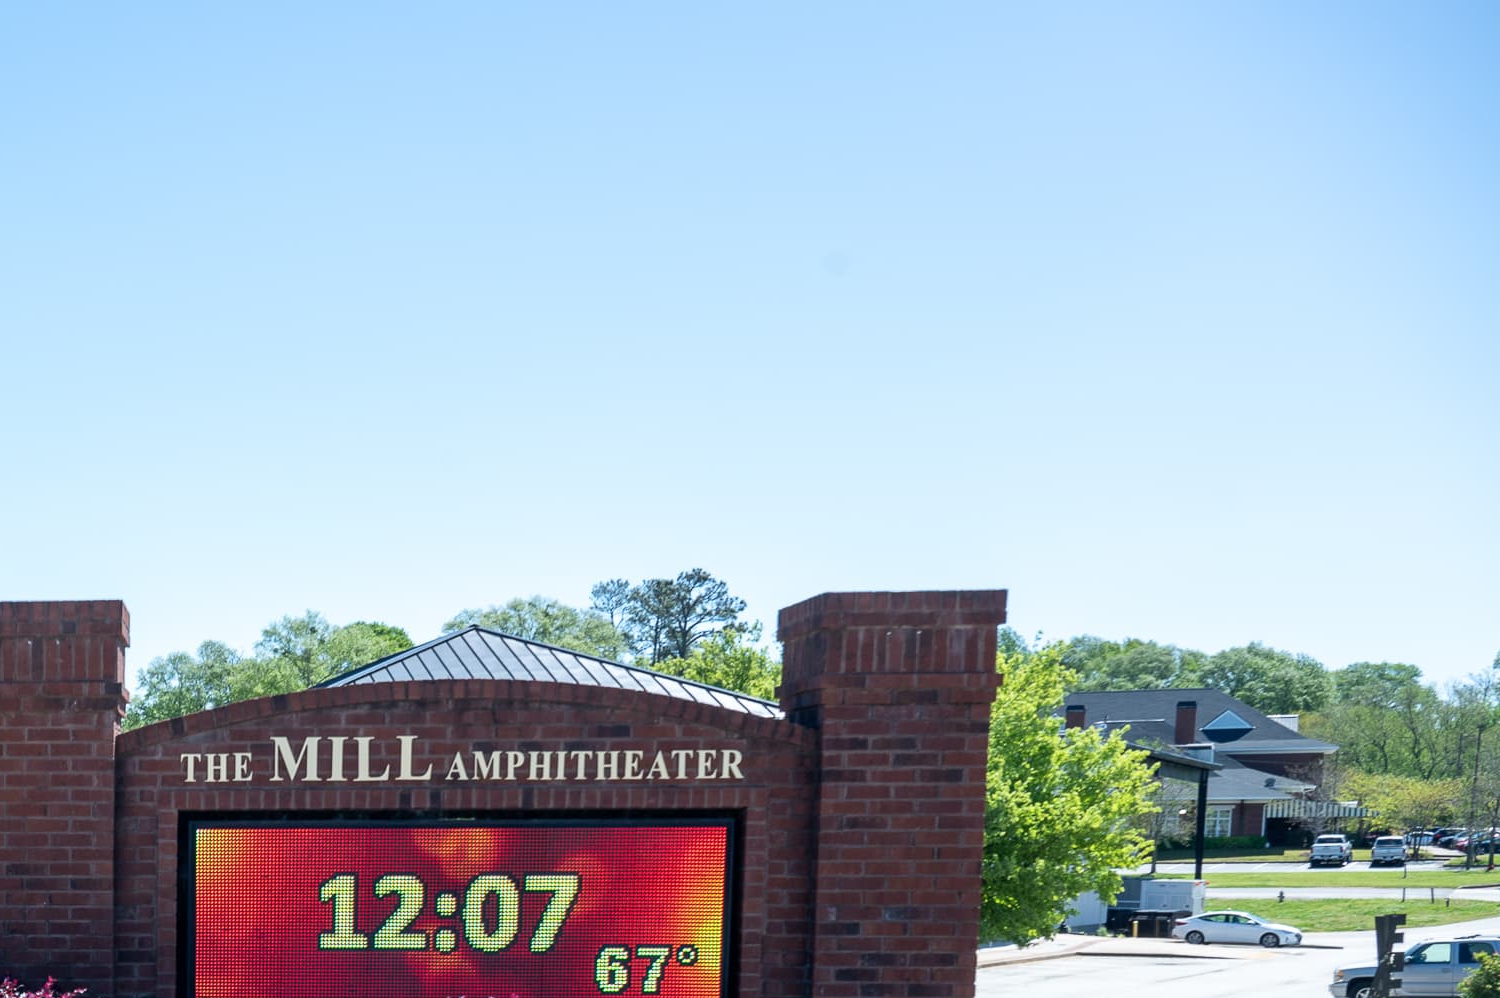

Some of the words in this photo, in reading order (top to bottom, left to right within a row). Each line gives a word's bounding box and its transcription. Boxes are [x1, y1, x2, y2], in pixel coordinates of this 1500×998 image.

[180, 752, 253, 783] THE
[269, 735, 433, 782] MILL
[445, 749, 745, 781] AMPHITHEATER
[318, 873, 582, 954] 12:07
[595, 945, 698, 995] 67°
